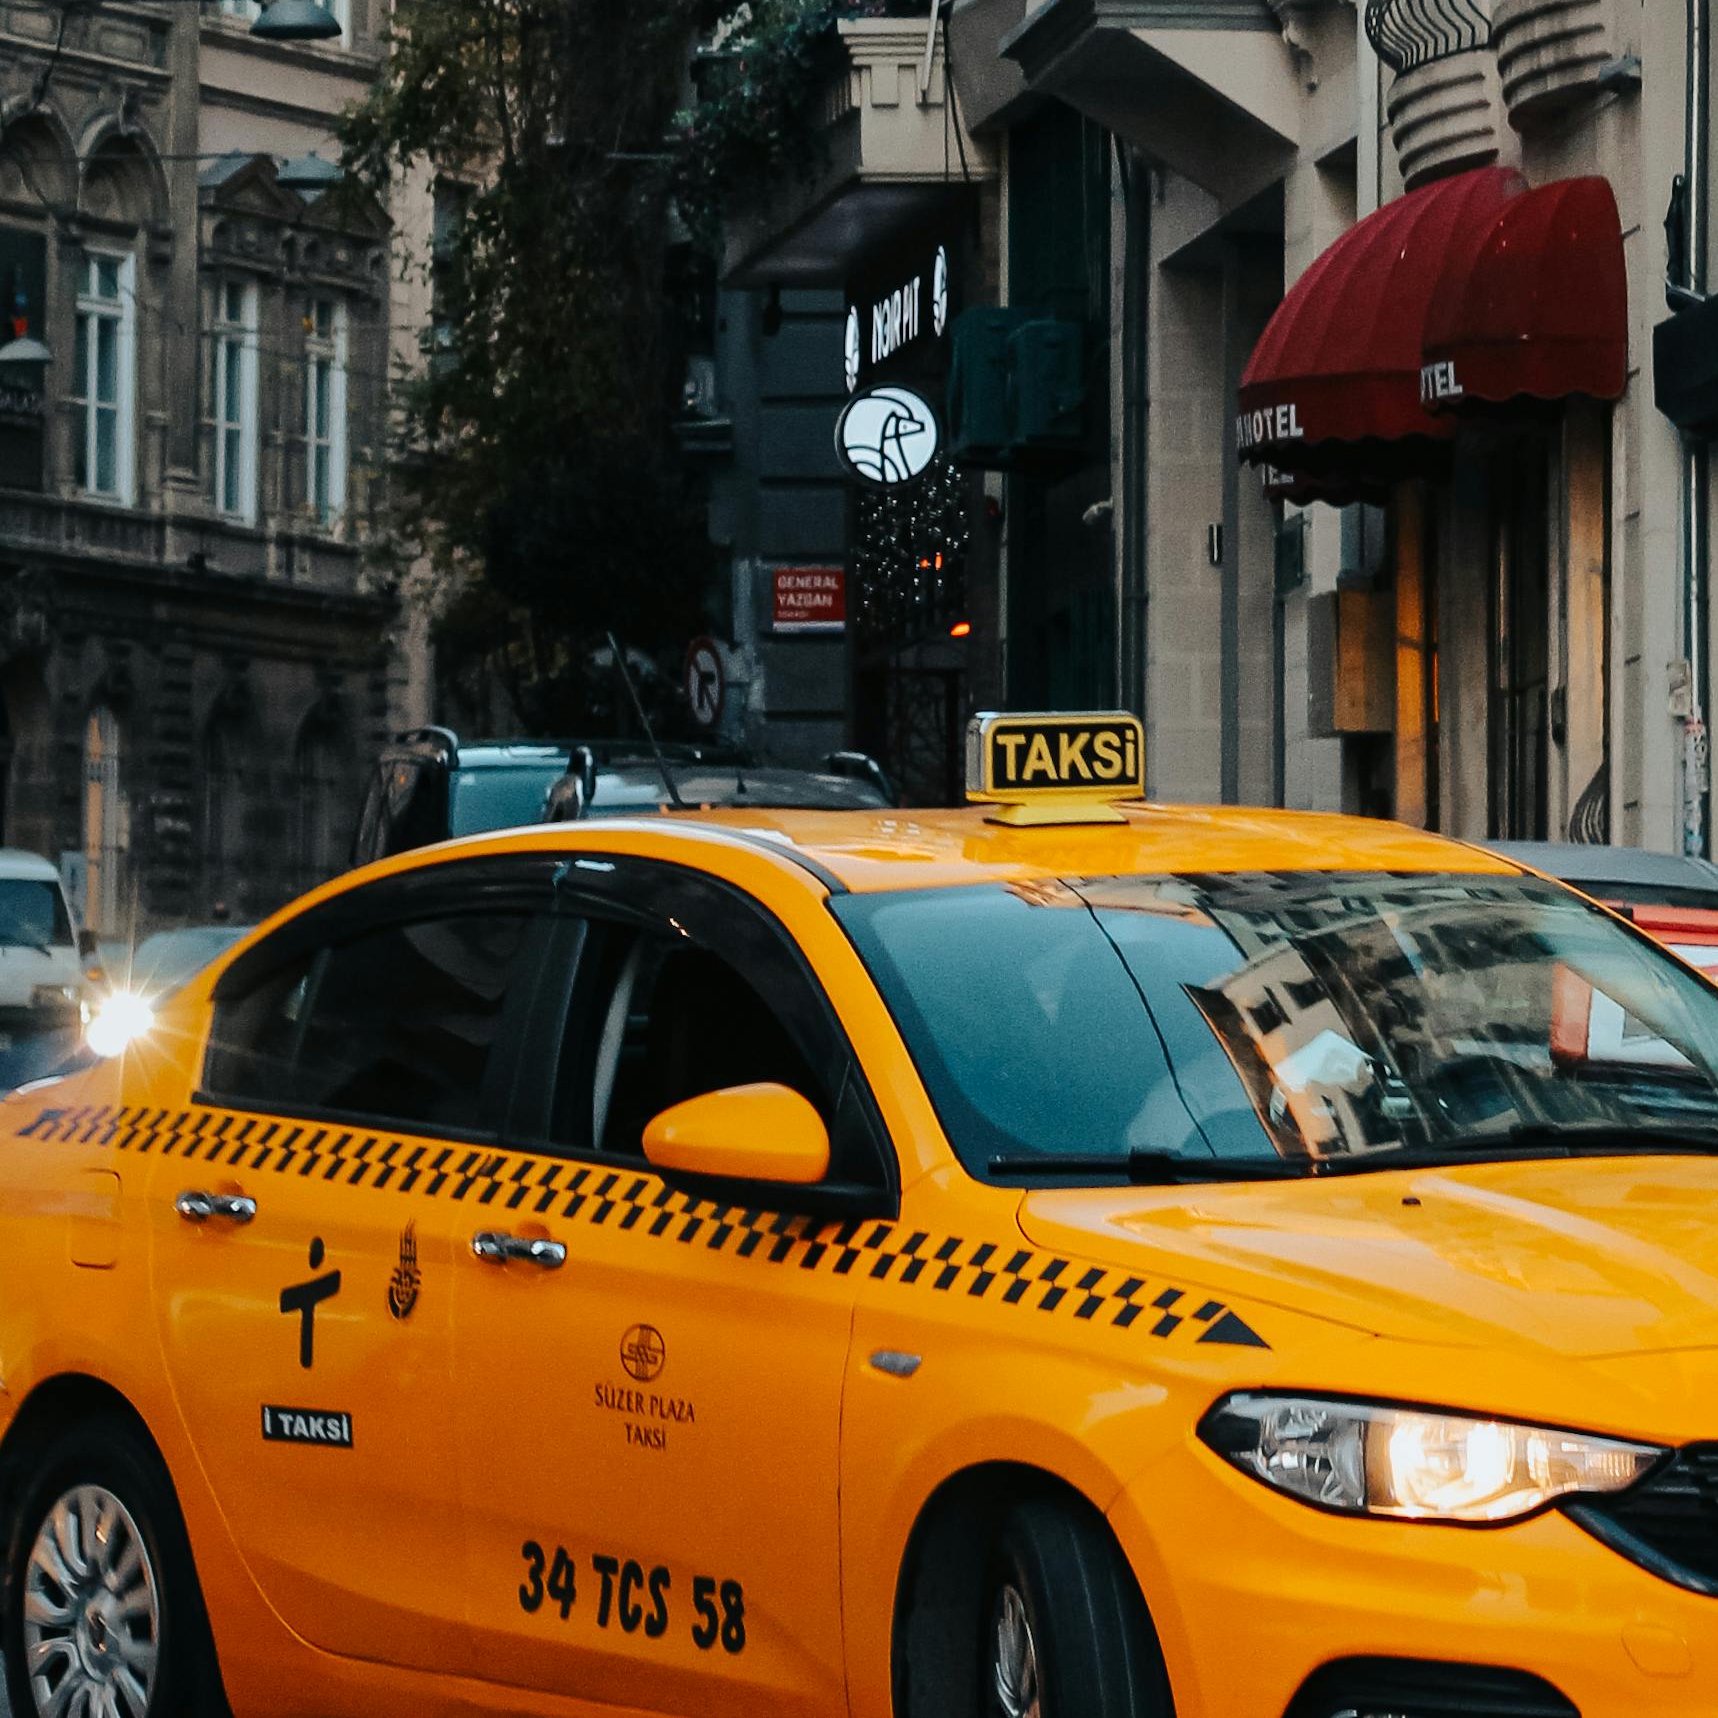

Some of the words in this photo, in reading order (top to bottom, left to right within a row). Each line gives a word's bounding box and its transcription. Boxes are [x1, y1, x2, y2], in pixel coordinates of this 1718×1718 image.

[777, 575, 839, 590] GENERAL
[650, 1395, 695, 1423] PLAZA
[519, 1540, 576, 1619] 34
[592, 1554, 671, 1637] TCS
[692, 1576, 746, 1653] 58
